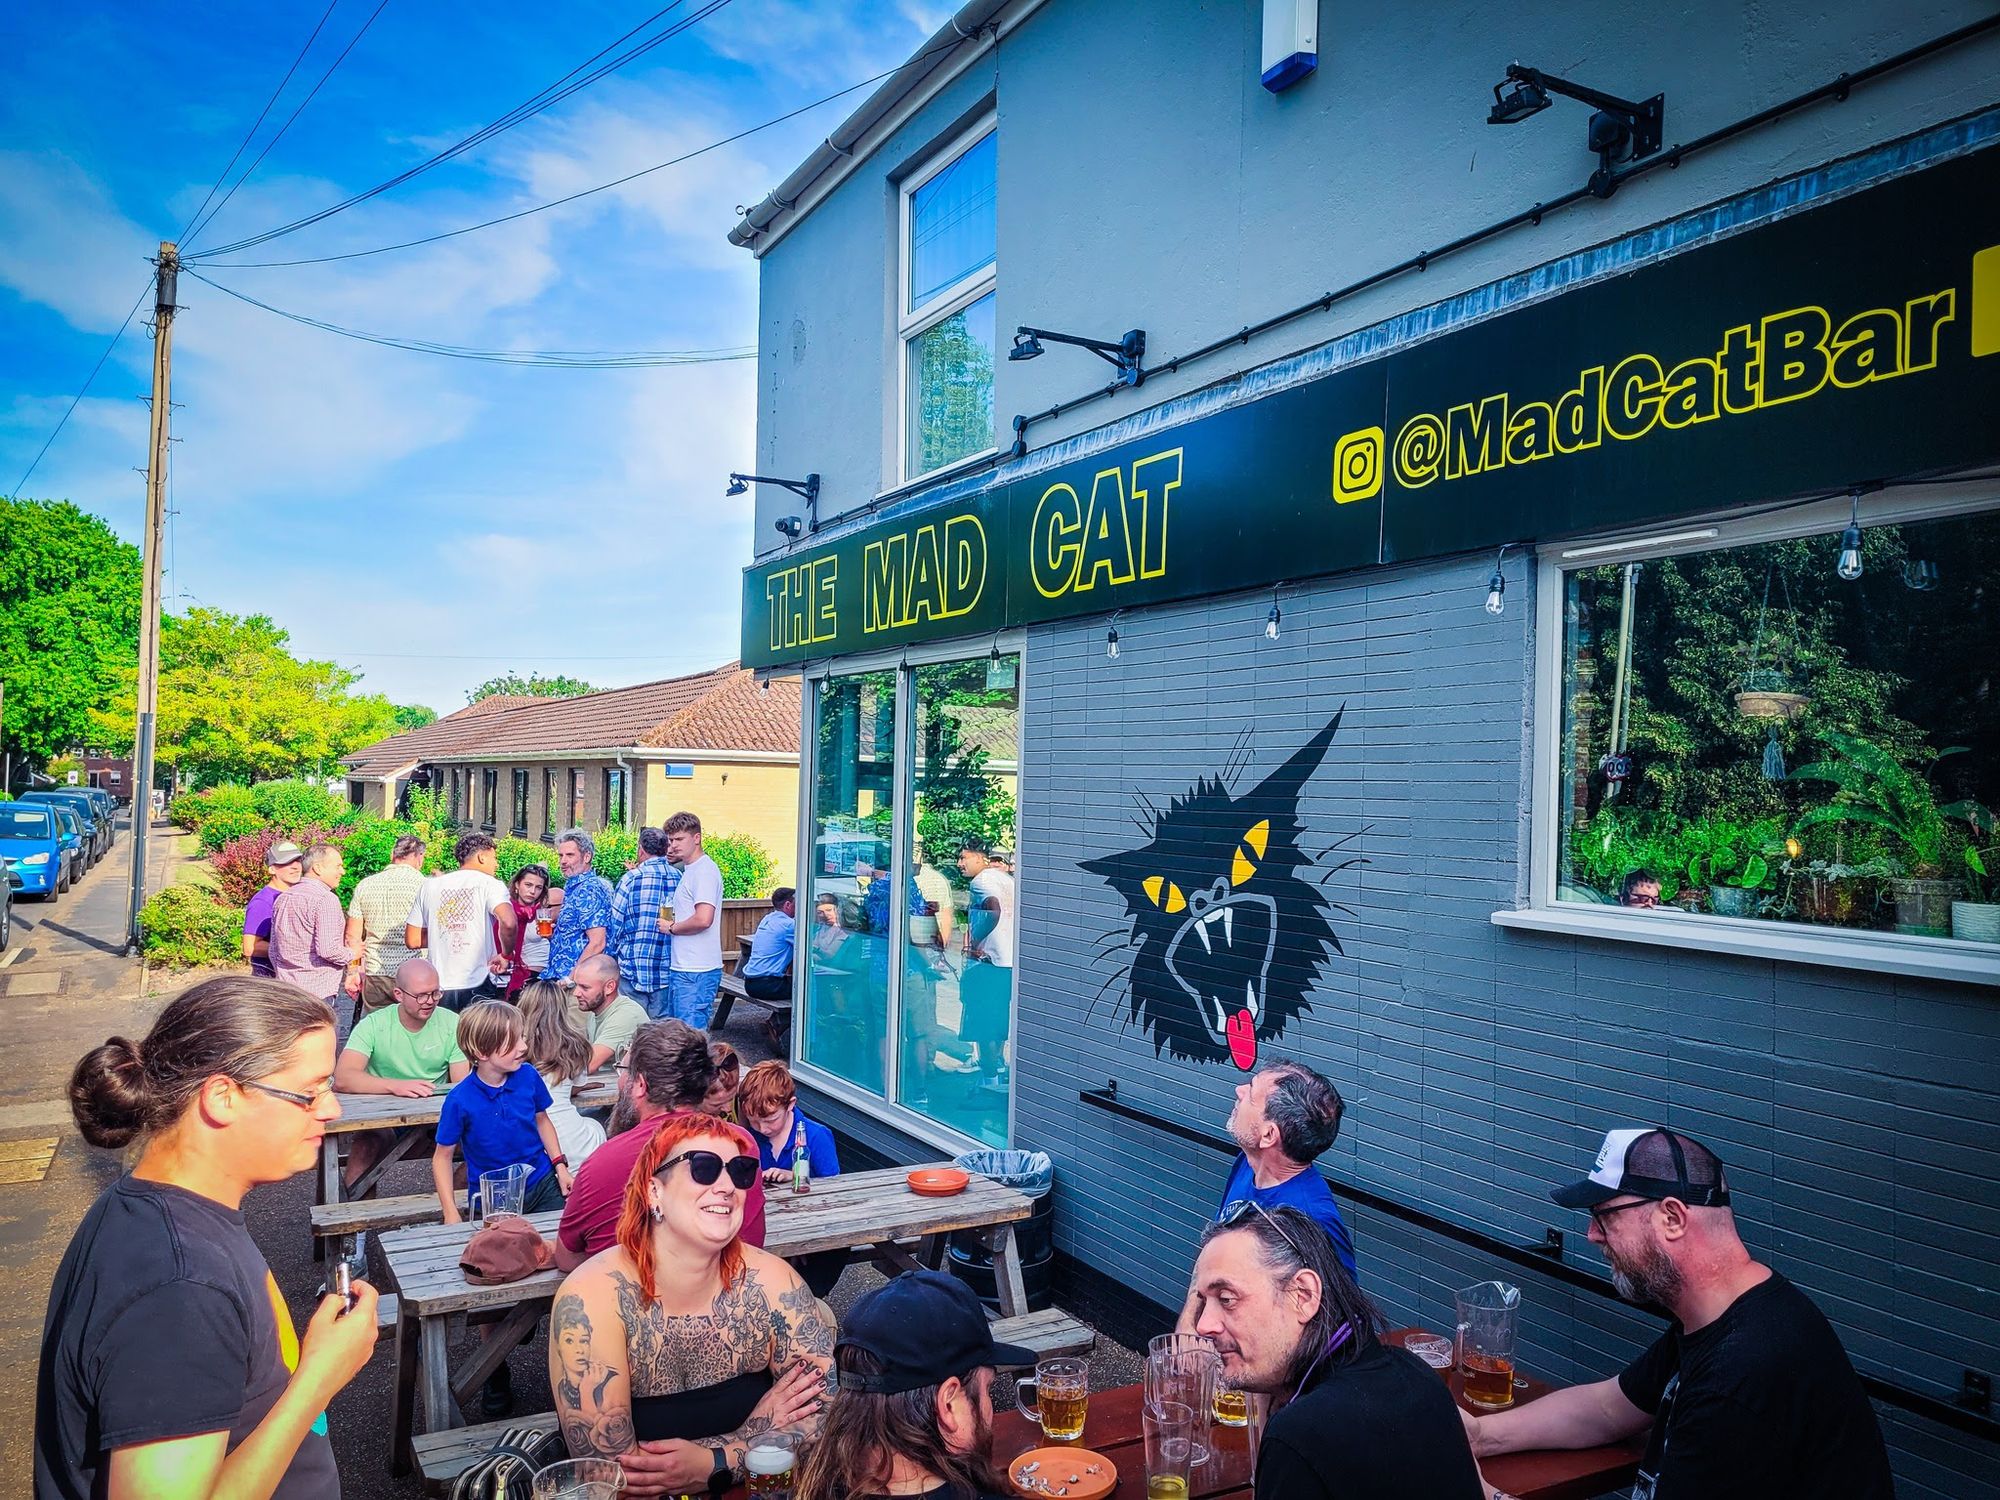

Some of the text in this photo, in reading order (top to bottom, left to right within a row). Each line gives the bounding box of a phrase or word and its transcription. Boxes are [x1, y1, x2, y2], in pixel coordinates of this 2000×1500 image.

[1392, 287, 1956, 489] @MadCatBar
[766, 446, 1184, 652] THE MAD CAT
